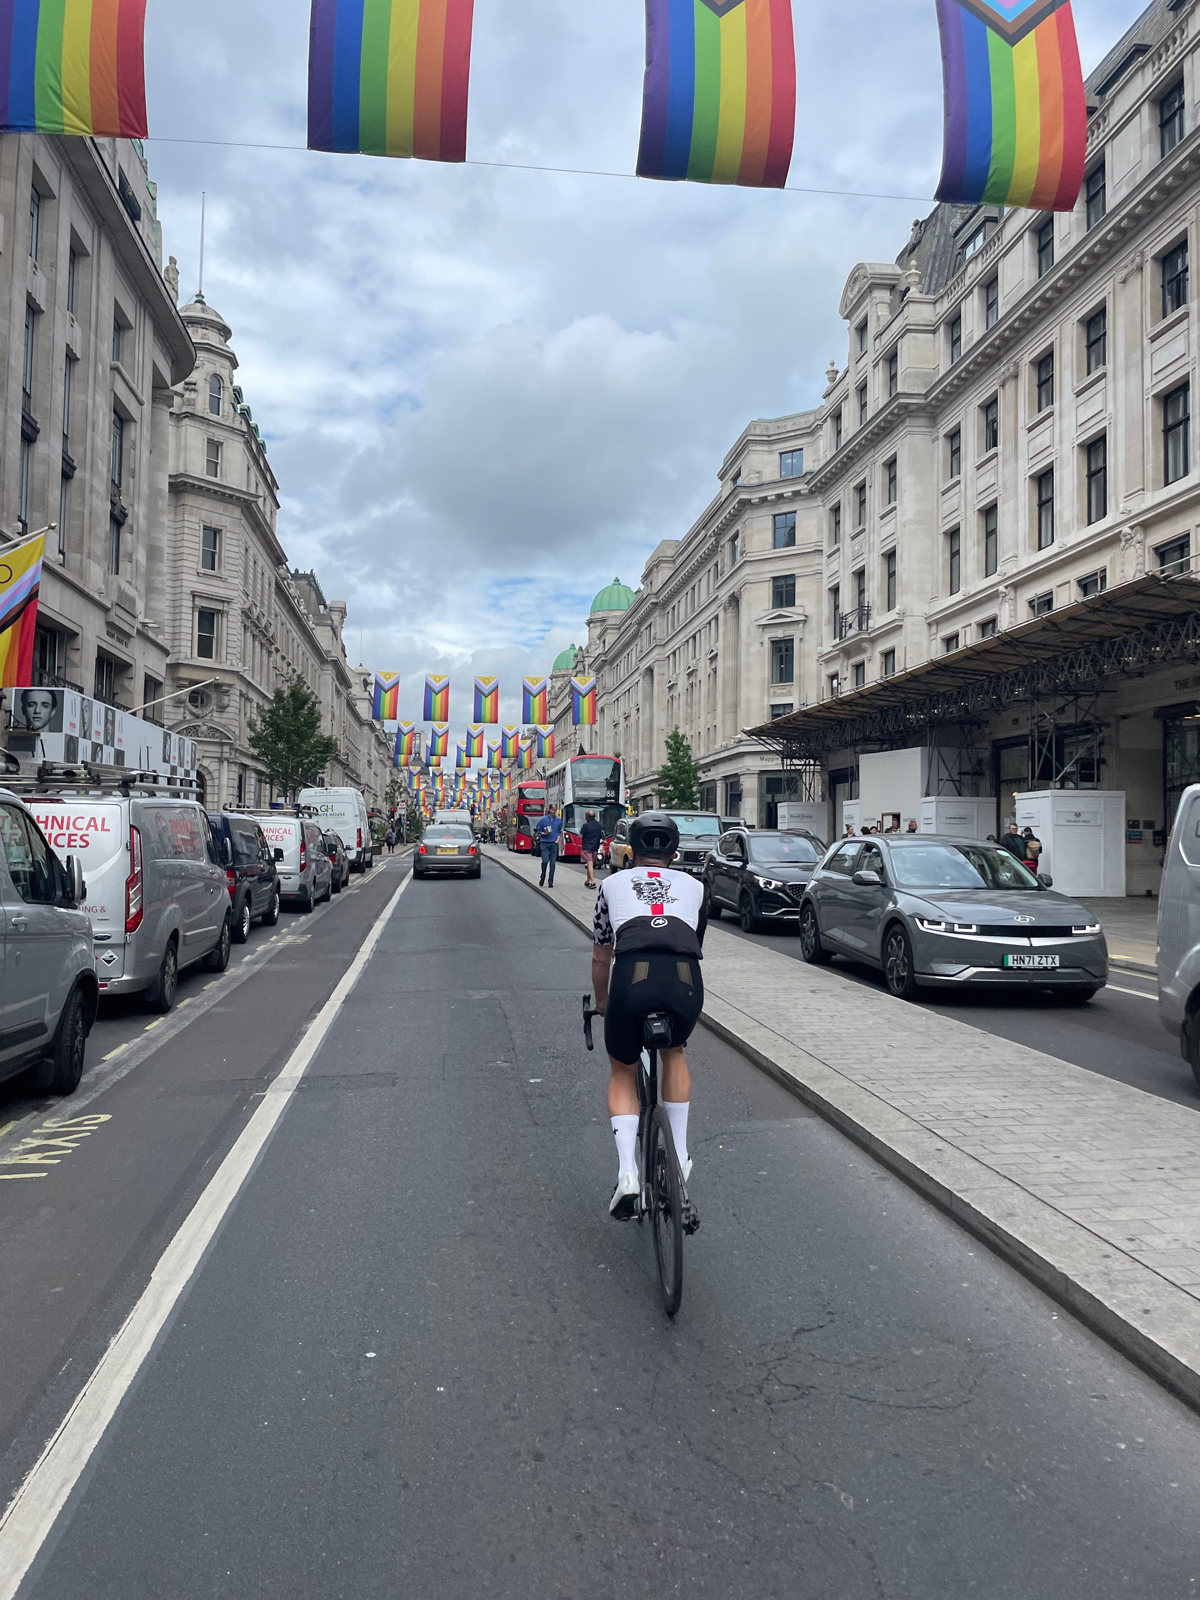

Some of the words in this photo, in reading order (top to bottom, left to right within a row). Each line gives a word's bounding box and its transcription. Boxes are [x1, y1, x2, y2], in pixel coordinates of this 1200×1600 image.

[262, 827, 292, 835] HNICAL
[99, 905, 107, 913] &
[1012, 955, 1035, 966] HN71
[1037, 955, 1057, 966] ZTX
